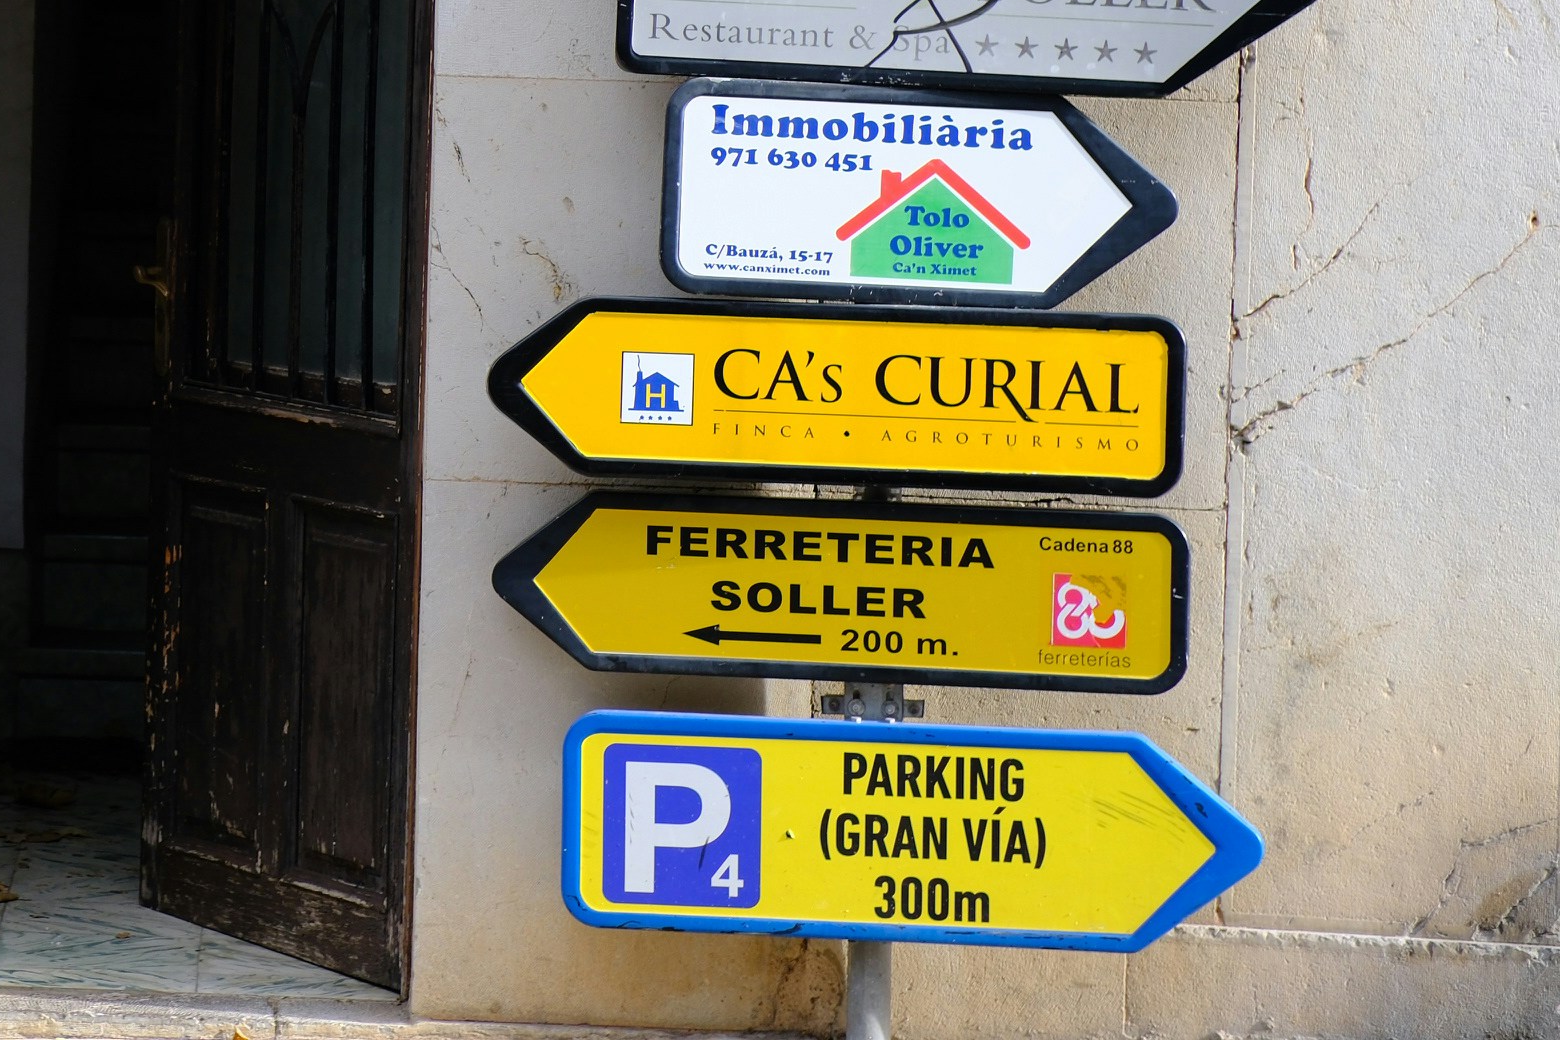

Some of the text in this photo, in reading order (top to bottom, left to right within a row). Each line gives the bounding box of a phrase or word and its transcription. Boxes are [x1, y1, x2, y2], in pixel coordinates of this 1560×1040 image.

[648, 12, 951, 62] Restaurant & Spa
[710, 103, 1034, 152] Immobiliària
[710, 146, 874, 172] 971 630 451
[904, 205, 970, 228] Tolo
[705, 243, 834, 264] C/Bauzá, 15-17
[889, 234, 984, 259] Oliver
[703, 262, 831, 277] www.canximet.com
[892, 262, 977, 276] Ca'n Ximet
[645, 383, 666, 409] H
[874, 353, 1140, 422] CURIAL
[712, 422, 1140, 453] FINCA AGROTURISMO
[644, 525, 996, 569] FERRETERIA
[1039, 536, 1134, 554] Cadena 88
[710, 580, 927, 620] SOLLER
[839, 628, 959, 658] 200 m.
[1038, 649, 1132, 668] ferreterías
[842, 751, 1025, 803] PARKING
[623, 760, 732, 893] P
[819, 805, 1048, 868] (GRAN VÍA)
[710, 853, 744, 898] 4
[873, 874, 991, 924] 300m
